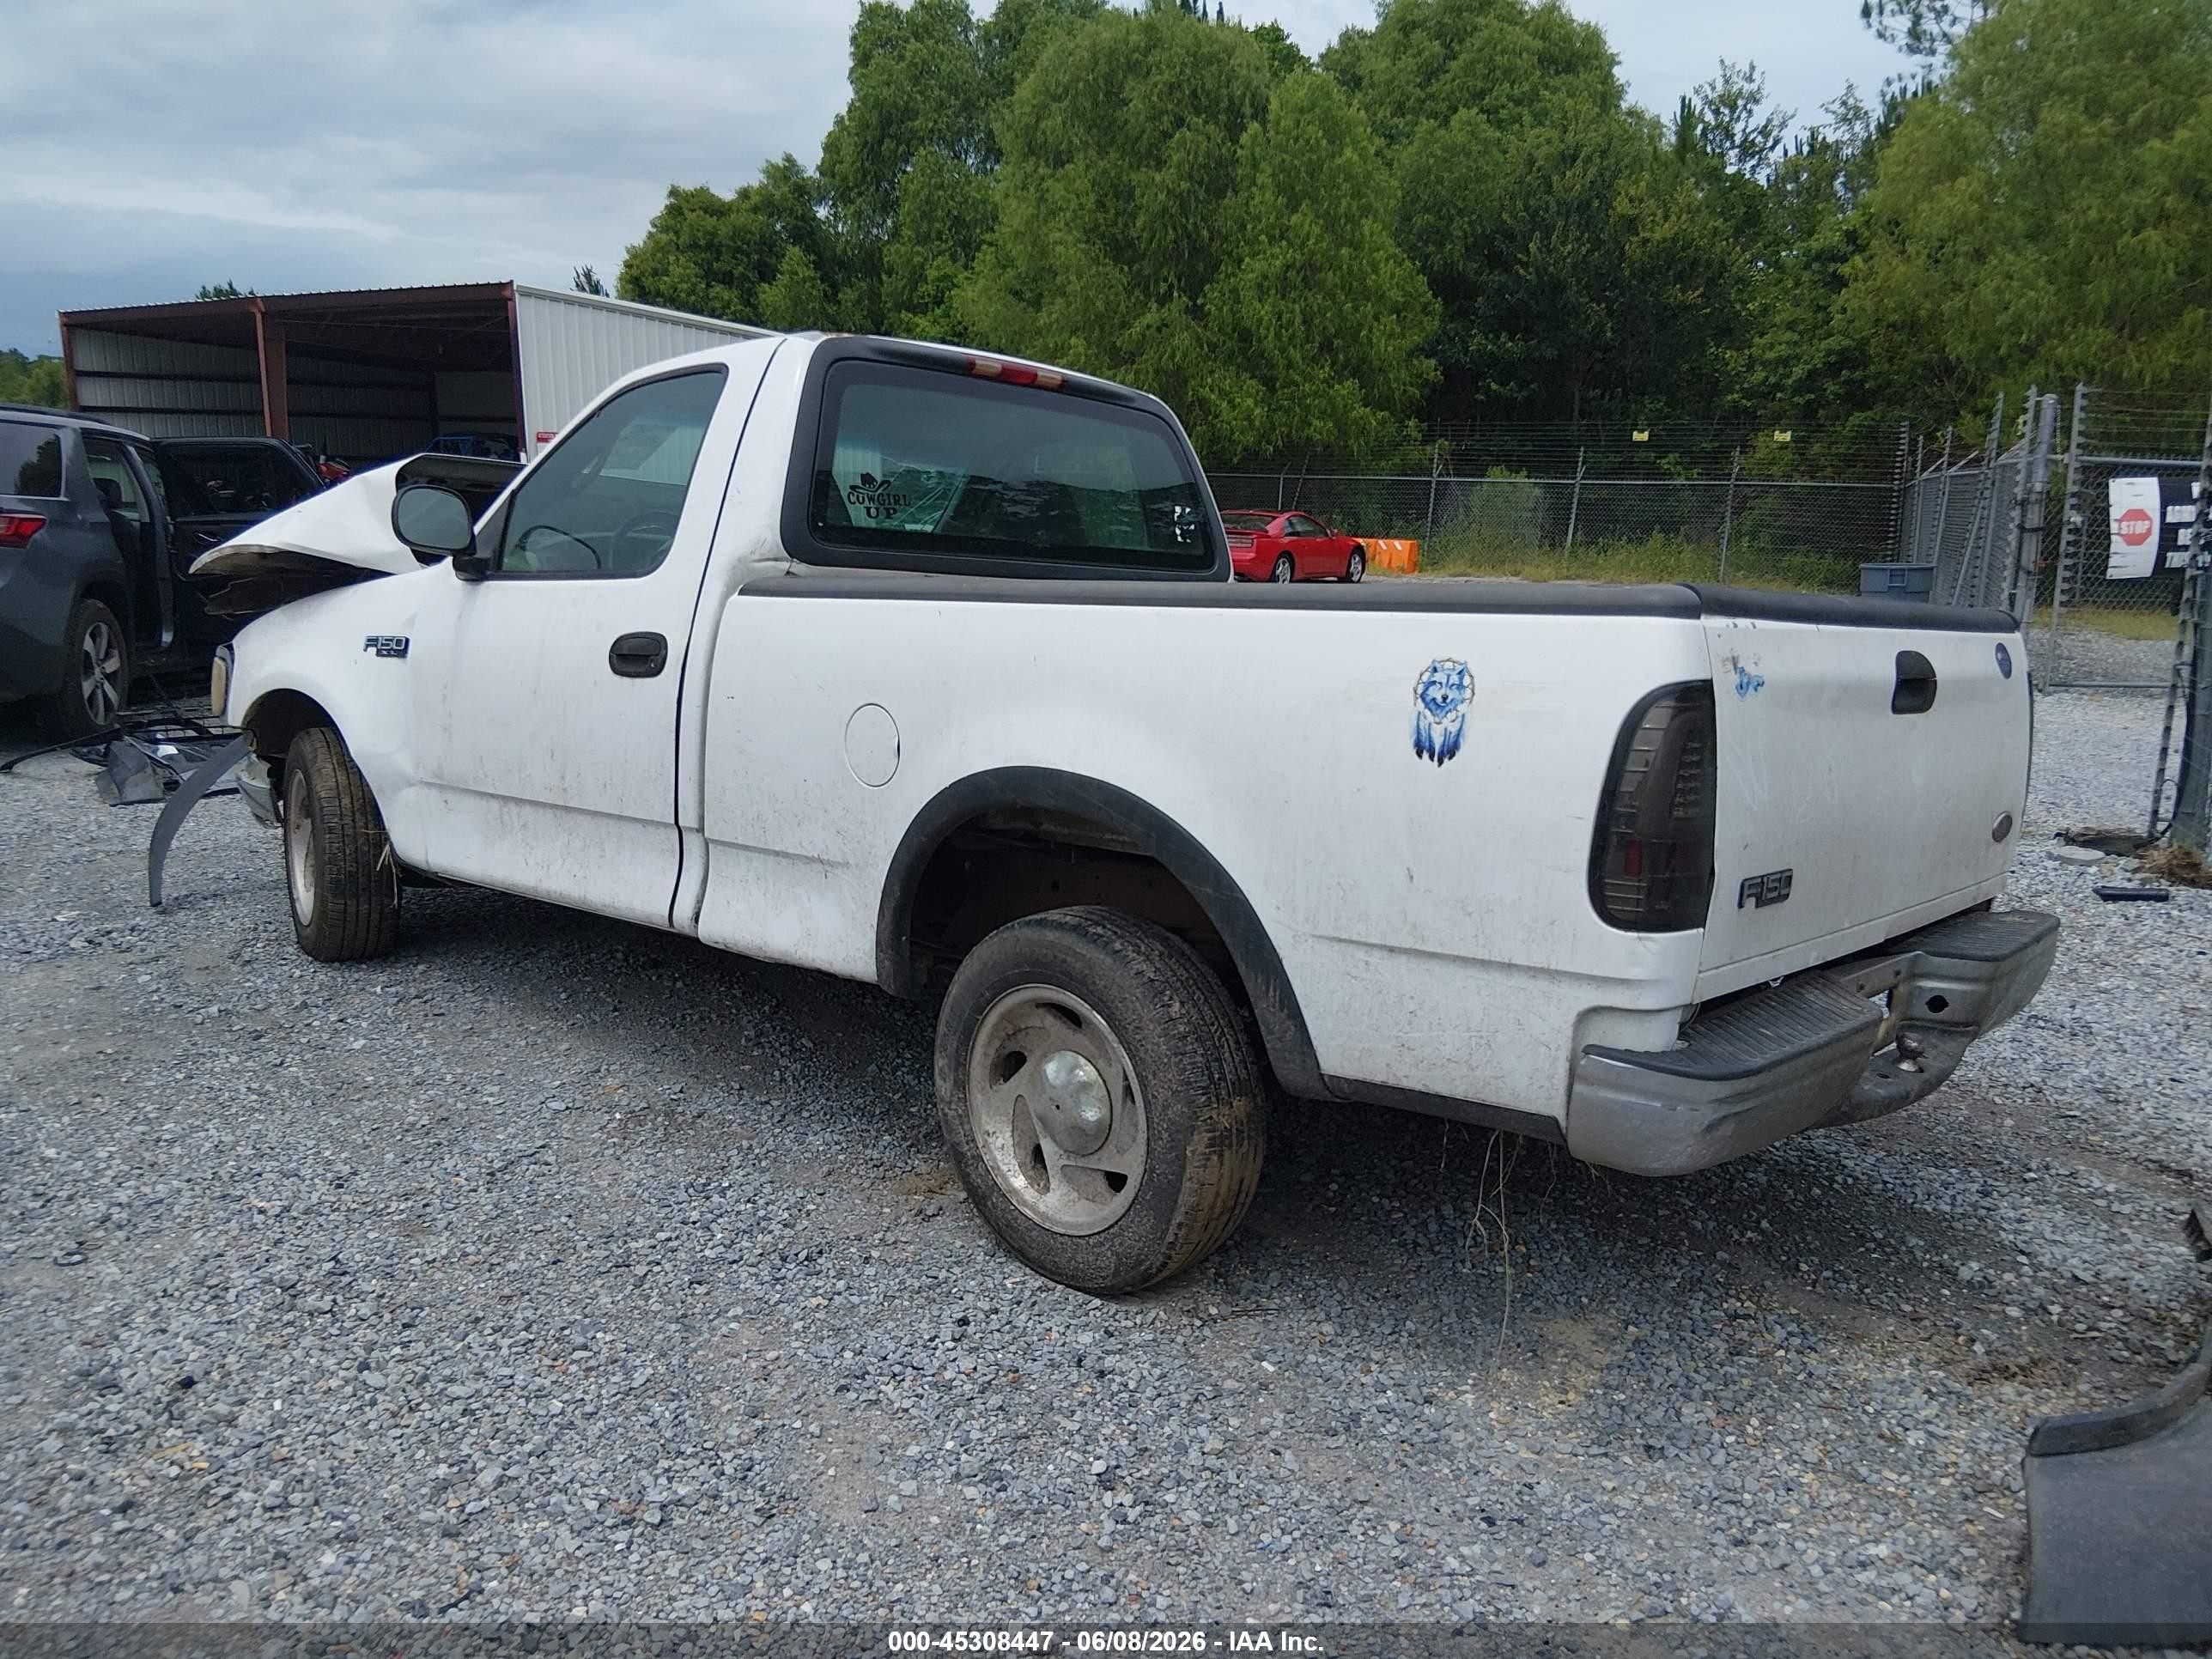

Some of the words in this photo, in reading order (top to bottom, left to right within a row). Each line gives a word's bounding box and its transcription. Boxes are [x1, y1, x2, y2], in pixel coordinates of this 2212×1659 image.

[848, 491, 910, 507] COWGIRL
[864, 506, 898, 520] UP
[2120, 520, 2151, 534] STOP
